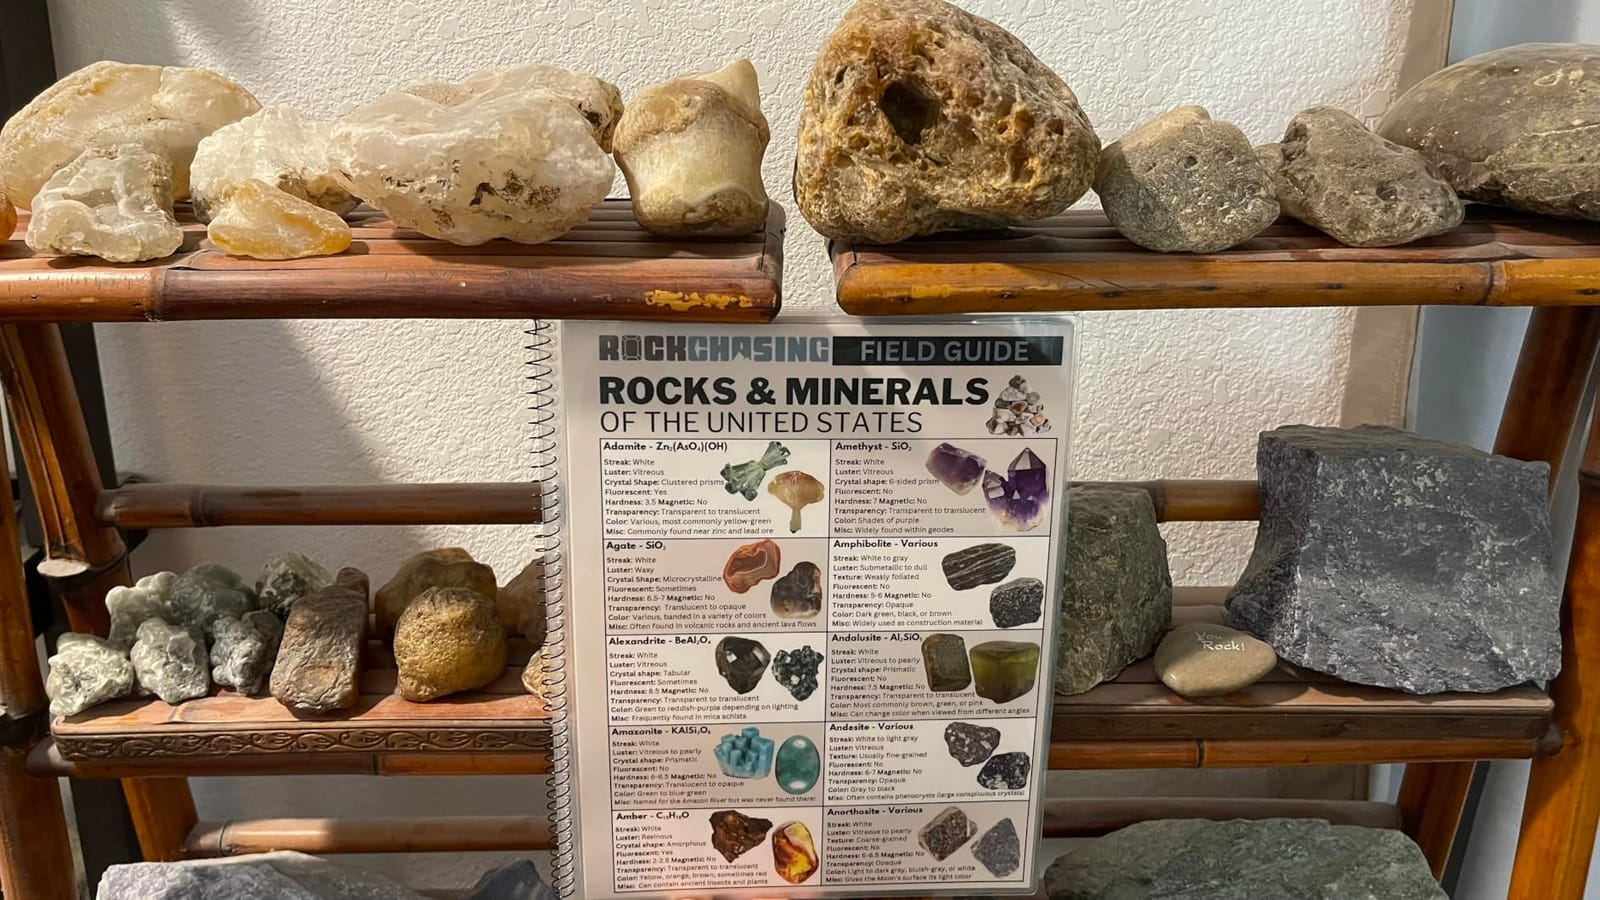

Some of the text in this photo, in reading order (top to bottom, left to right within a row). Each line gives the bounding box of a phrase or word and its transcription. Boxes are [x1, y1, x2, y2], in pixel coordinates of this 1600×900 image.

[861, 341, 941, 361] FIELD
[944, 341, 1029, 361] GUIDE
[600, 376, 989, 405] ROCKS & MINERALS
[601, 411, 922, 433] OF THE UNITED STATES
[603, 442, 646, 451] Adamite
[835, 442, 882, 452] Amethyst
[604, 479, 632, 487] Crystal
[835, 478, 861, 486] Crystal
[918, 478, 939, 486] prism
[661, 508, 706, 516] Transparent
[889, 507, 932, 515] Transparent
[683, 518, 722, 526] commonly
[724, 518, 771, 526] yellow-green
[855, 527, 879, 535] Widely
[928, 526, 954, 534] geodes
[606, 541, 636, 551] Agate
[833, 539, 891, 549] Amphibolite
[901, 539, 938, 548] Various
[607, 576, 634, 584] Crystal
[663, 575, 722, 583] Microcrystalline
[852, 620, 876, 628] Widely
[609, 636, 666, 645] Alexandrite
[832, 633, 881, 642] Andalusite
[1195, 632, 1222, 640] You
[1202, 641, 1245, 651] Rock!
[898, 657, 920, 665] pearly
[610, 670, 636, 678] Crystal
[831, 666, 856, 674] Crystal
[667, 705, 720, 713] reddish-purple
[722, 704, 760, 712] depending
[772, 704, 798, 712] lighting
[612, 727, 662, 735] Amazonite
[829, 723, 869, 731] Andesite
[878, 722, 914, 731] Various
[616, 811, 647, 820] Amber
[827, 806, 880, 816] Anorthosite
[888, 806, 923, 815] Various
